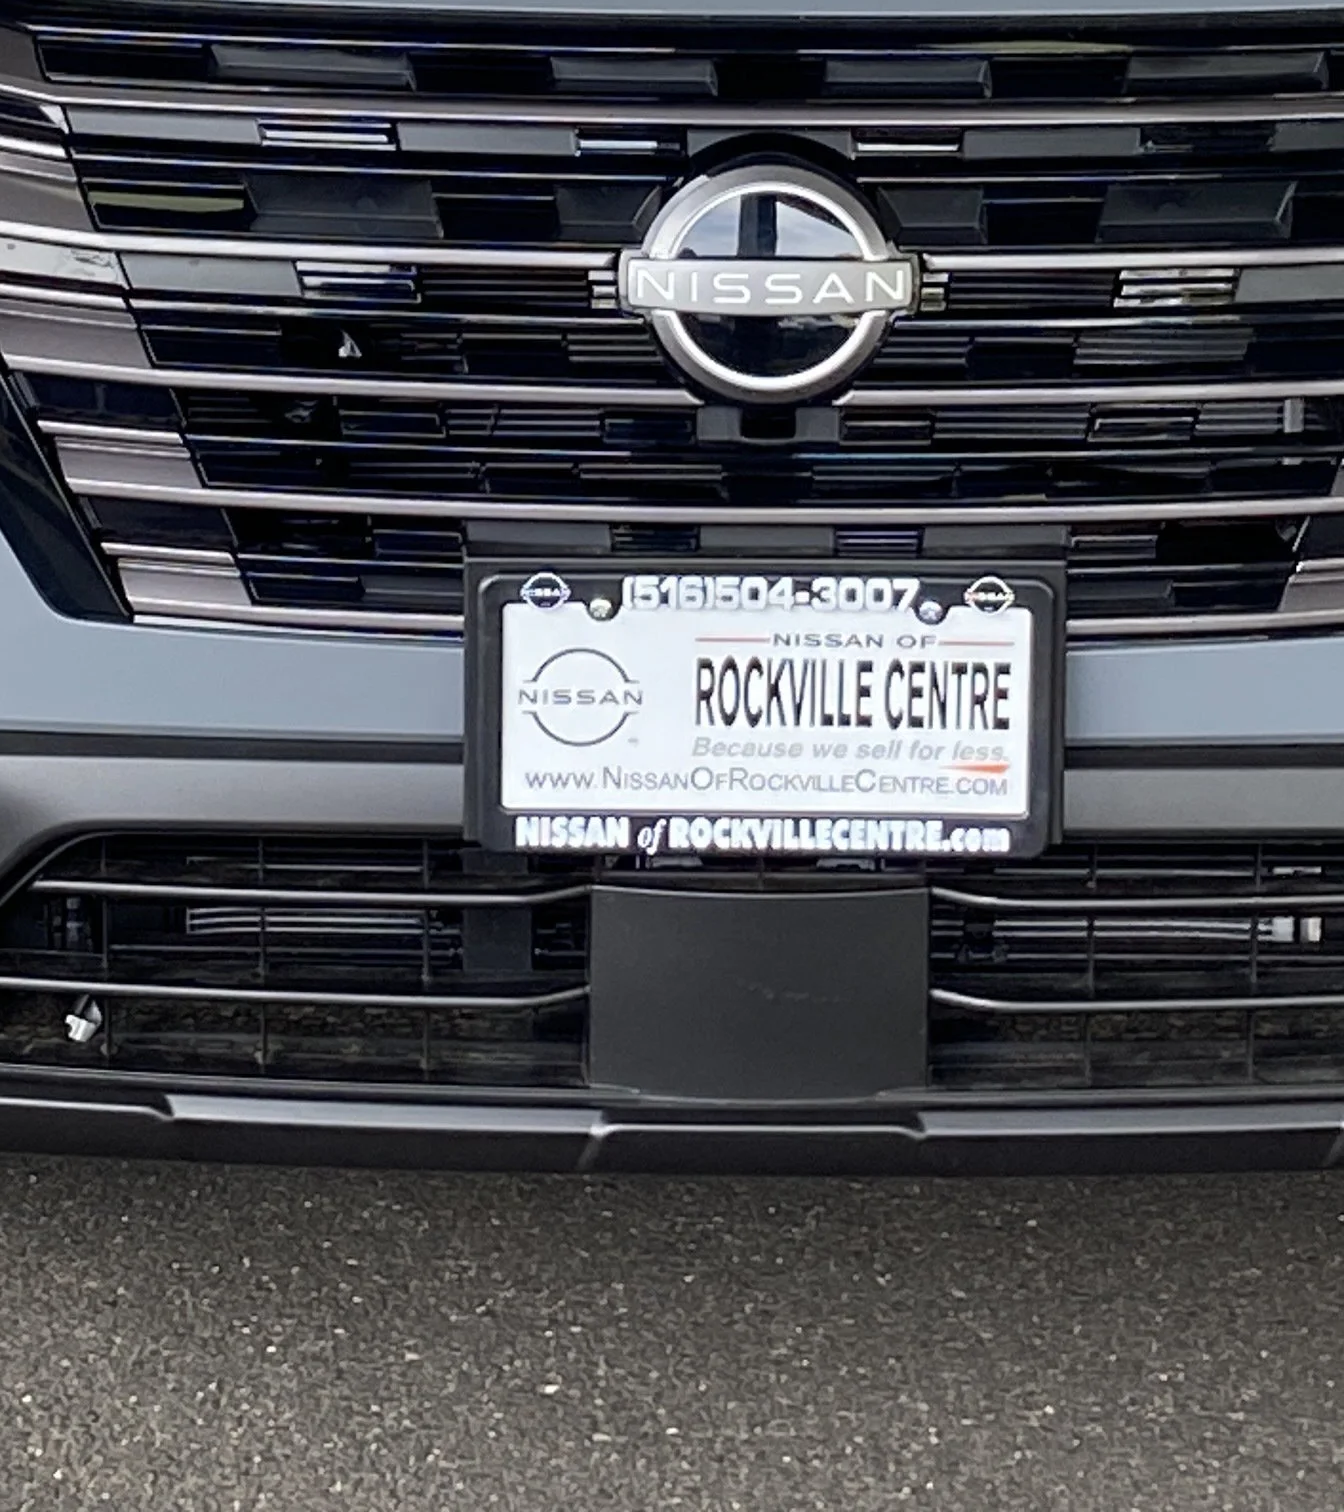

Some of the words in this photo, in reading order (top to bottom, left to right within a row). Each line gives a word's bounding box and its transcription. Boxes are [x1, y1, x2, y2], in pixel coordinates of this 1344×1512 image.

[636, 270, 905, 304] NISSAN
[622, 575, 921, 611] (516)504-3007
[773, 633, 885, 649] NISSAN
[896, 634, 937, 649] OF
[518, 688, 644, 706] NISSAN
[694, 655, 873, 728] ROCKVILLE
[884, 658, 1012, 731] CENTRE
[691, 736, 805, 758] Because
[812, 743, 849, 759] we
[855, 739, 903, 761] sell
[907, 740, 946, 762] for
[952, 740, 1009, 763] less.
[515, 816, 630, 849] NISSAN
[637, 818, 667, 856] of
[668, 817, 1011, 853] ROCKVILLECENTRE.com
